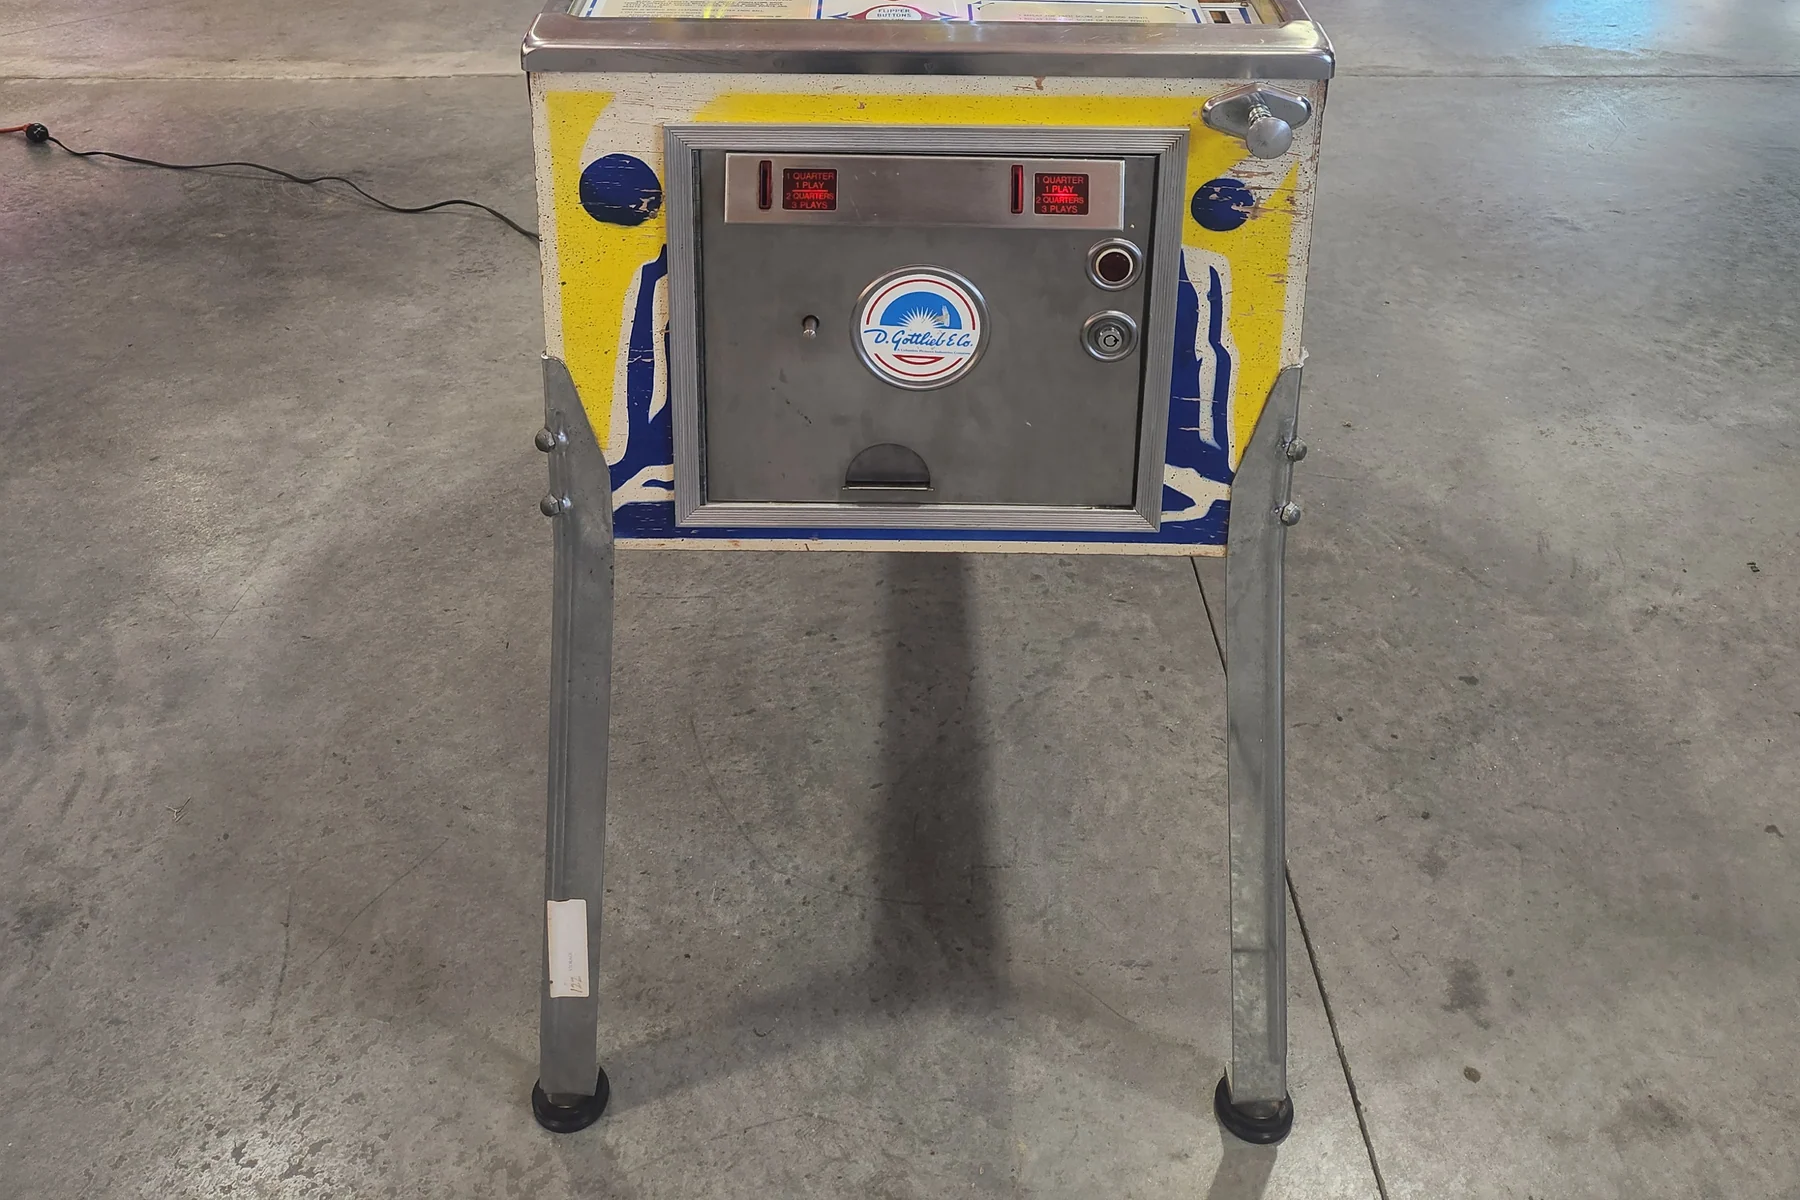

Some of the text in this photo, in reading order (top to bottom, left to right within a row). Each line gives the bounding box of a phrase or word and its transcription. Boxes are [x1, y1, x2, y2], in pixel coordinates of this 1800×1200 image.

[1043, 176, 1084, 184] QUARTER
[793, 192, 834, 200] QUARTERS
[864, 329, 889, 344] D.
[892, 330, 945, 351] Gottlieb
[957, 333, 973, 347] Co.
